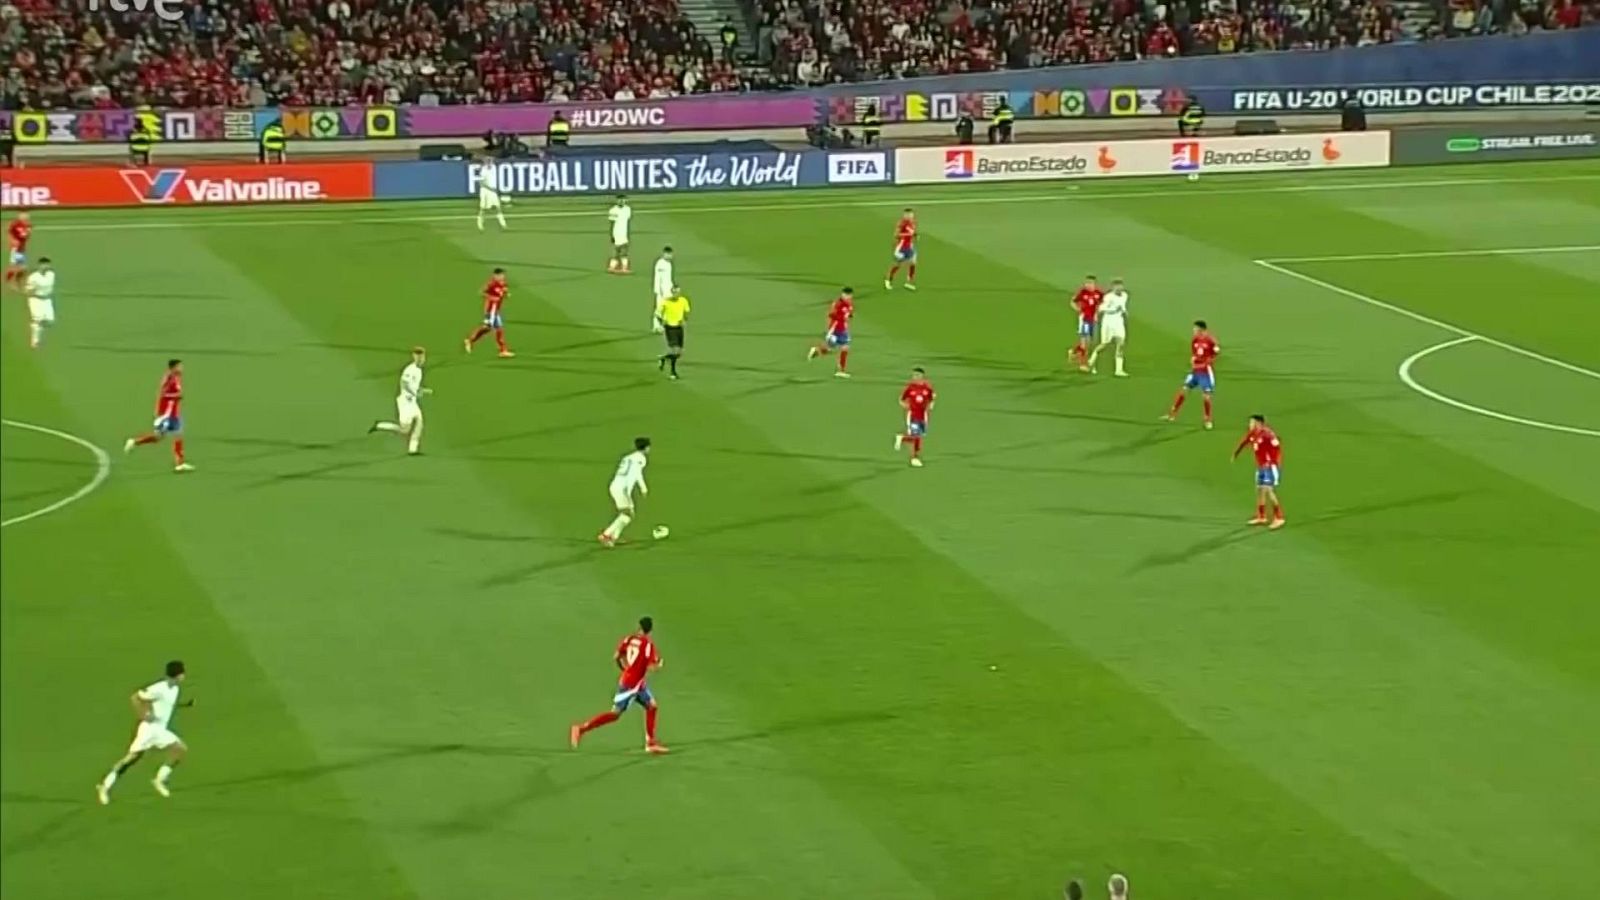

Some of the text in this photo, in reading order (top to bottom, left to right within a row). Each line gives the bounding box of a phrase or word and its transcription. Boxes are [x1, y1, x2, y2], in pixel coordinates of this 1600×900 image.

[1233, 91, 1283, 110] FIFA
[1286, 90, 1338, 109] U-20
[1425, 86, 1474, 105] CUP
[570, 108, 665, 128] #U20WC
[976, 155, 1087, 174] BancoEstado
[1202, 147, 1312, 166] BancoEstado
[467, 152, 801, 194] FOTBALL UNITES the World
[836, 160, 878, 175] FIFA
[184, 176, 321, 202] Valvoline
